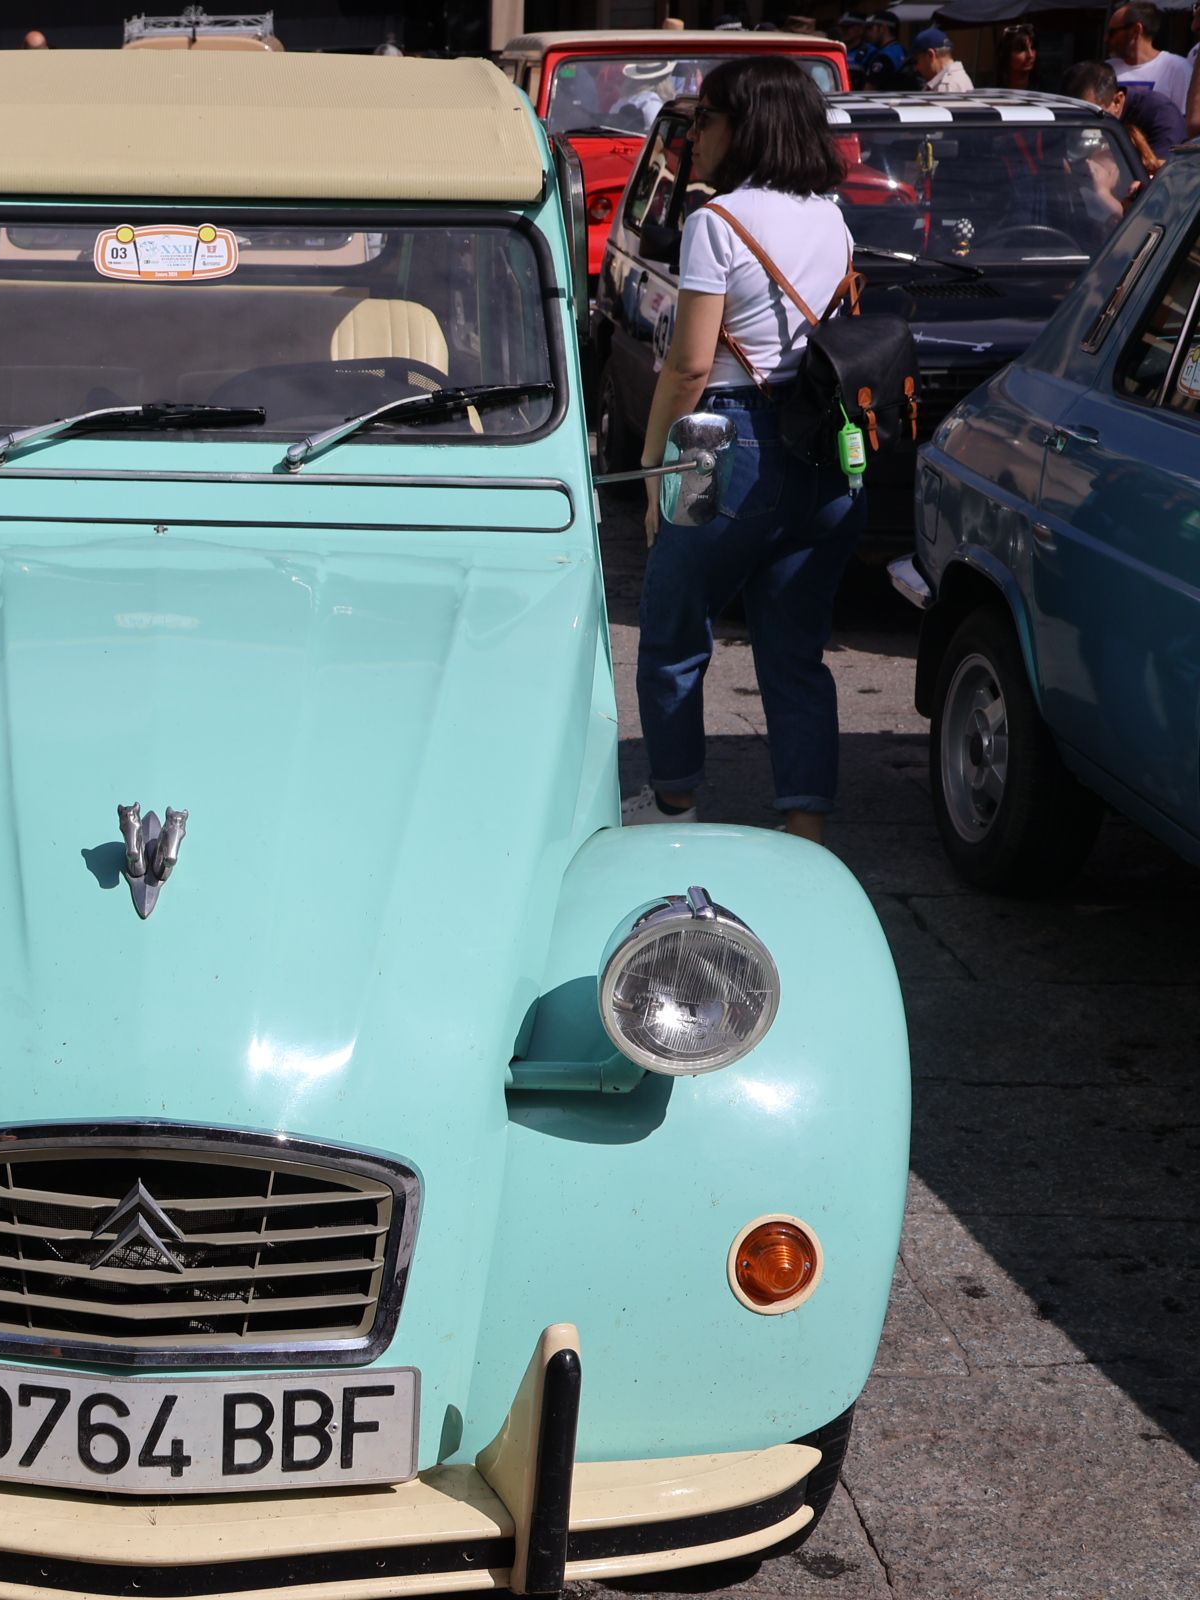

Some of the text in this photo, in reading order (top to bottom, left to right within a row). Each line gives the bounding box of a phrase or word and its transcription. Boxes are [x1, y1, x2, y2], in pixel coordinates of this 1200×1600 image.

[111, 247, 127, 259] 03
[161, 244, 193, 254] XXII
[222, 1385, 395, 1476] BBF
